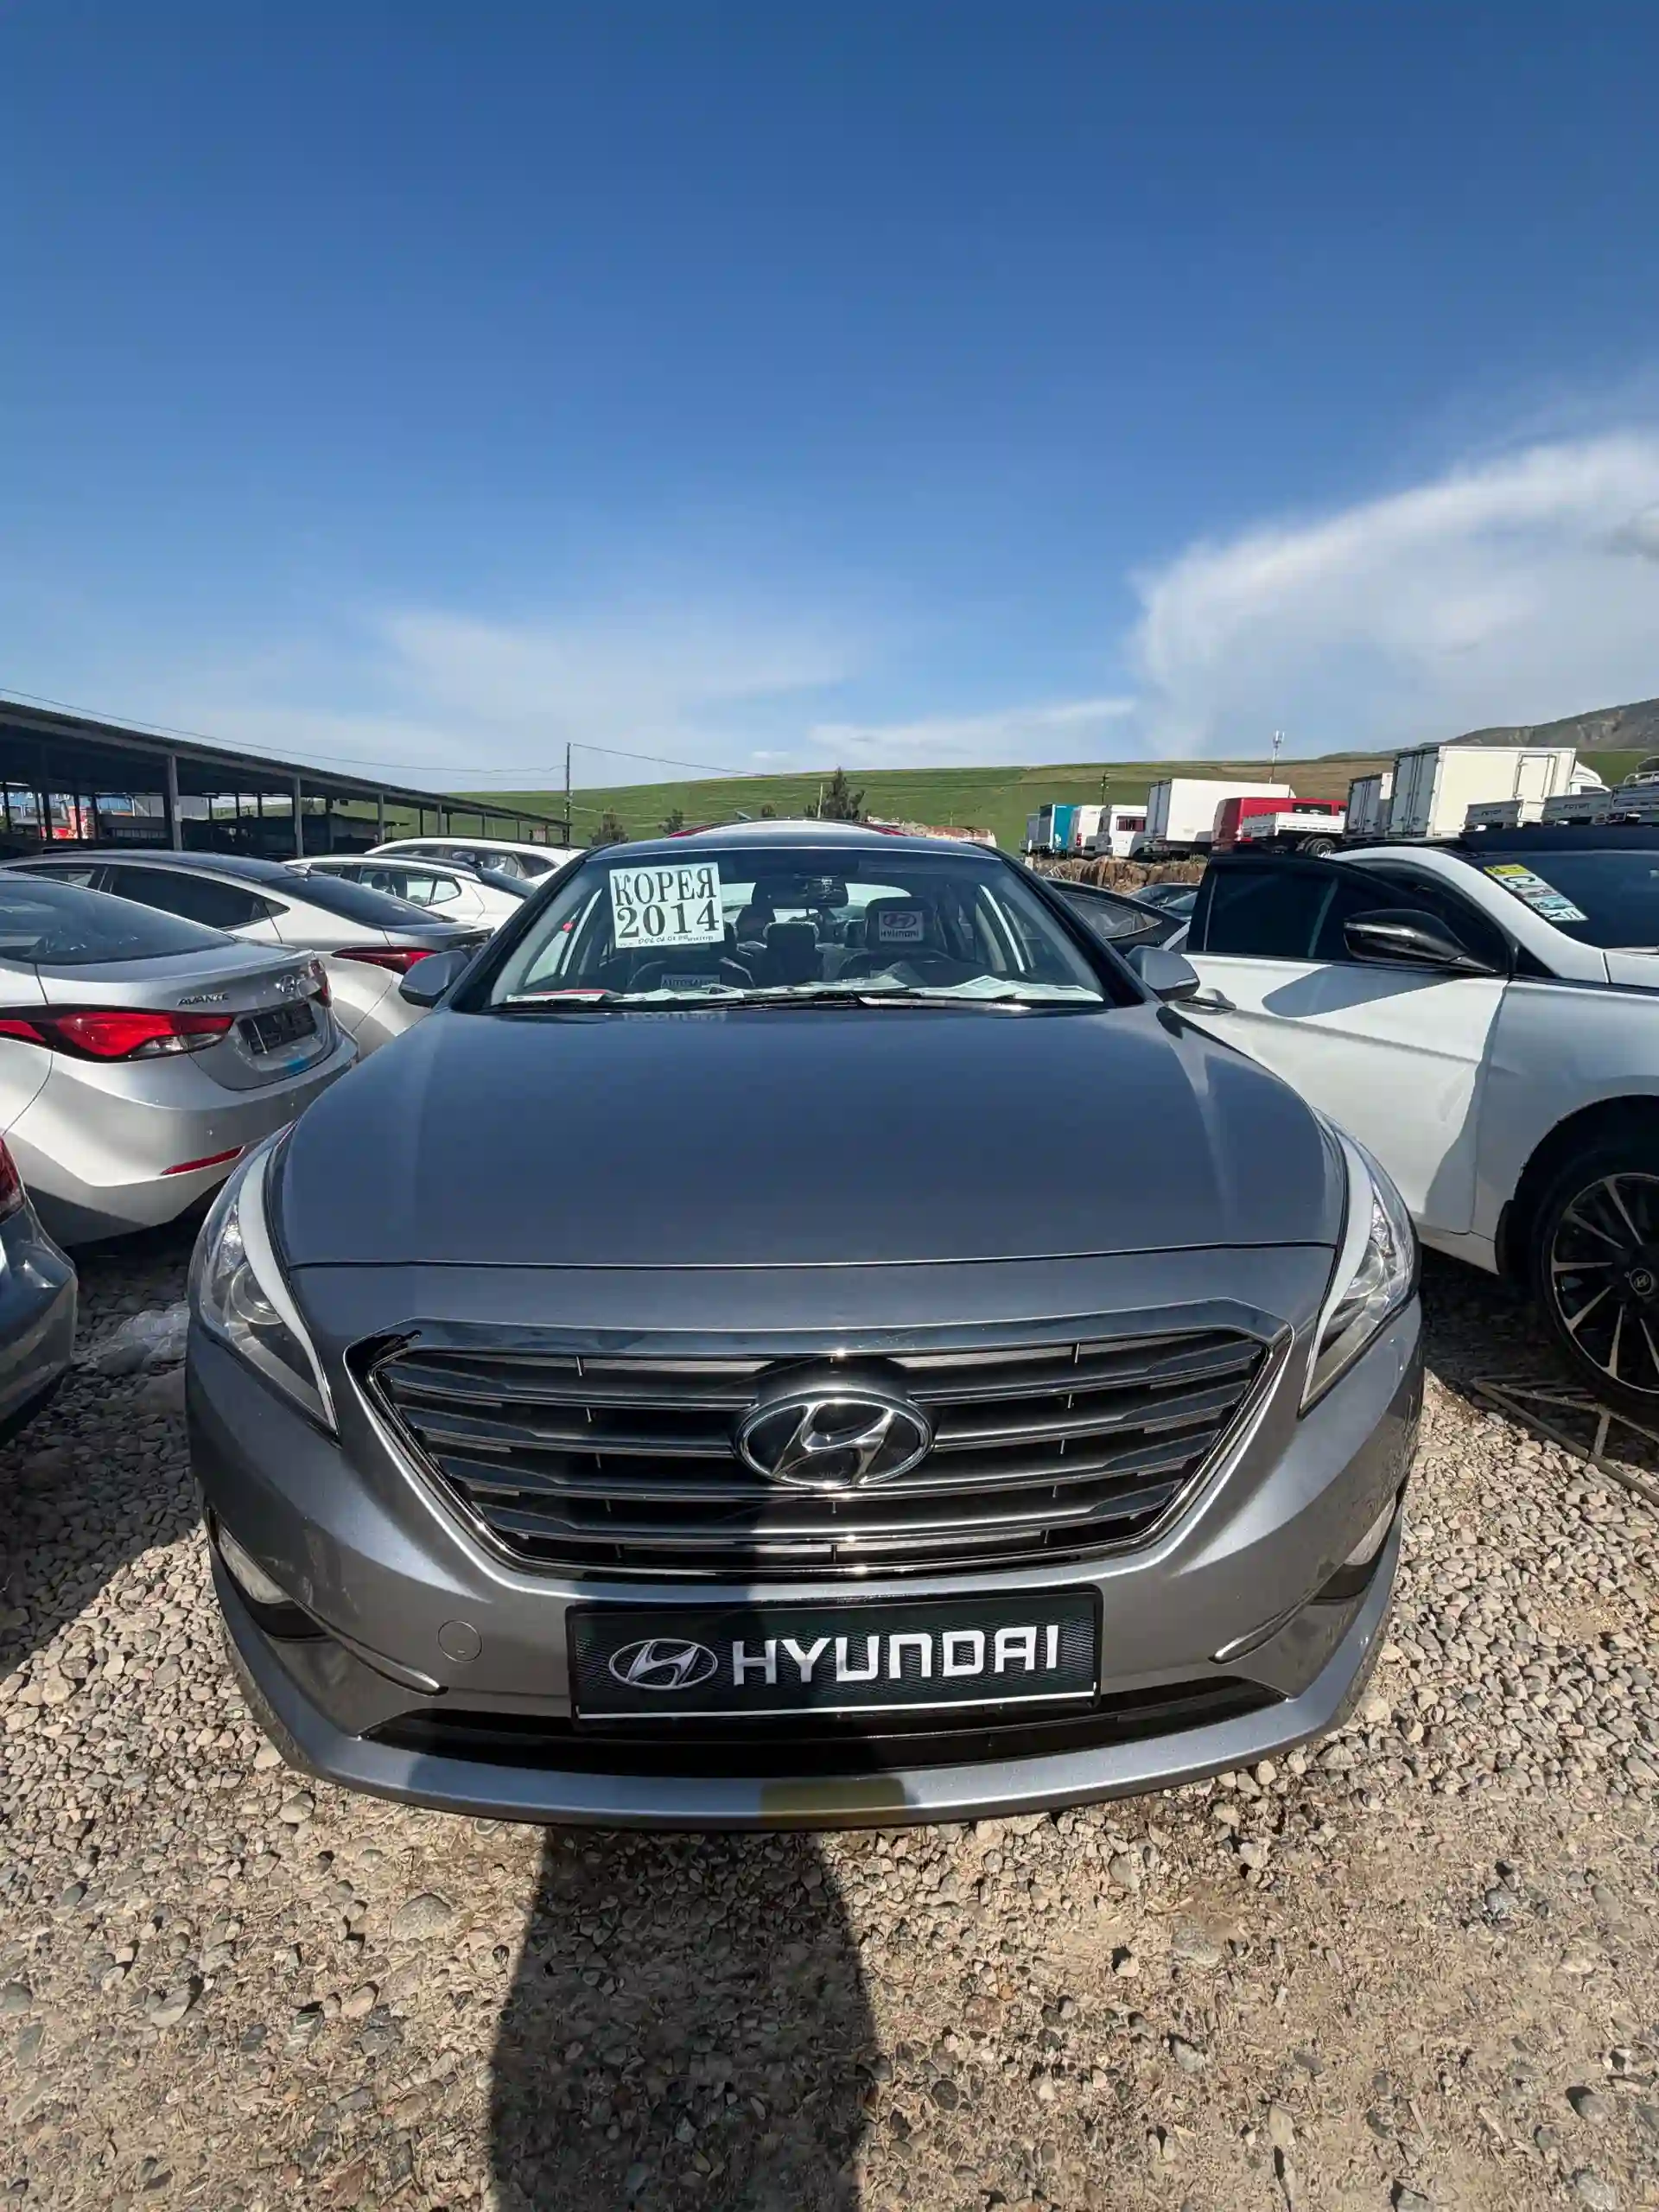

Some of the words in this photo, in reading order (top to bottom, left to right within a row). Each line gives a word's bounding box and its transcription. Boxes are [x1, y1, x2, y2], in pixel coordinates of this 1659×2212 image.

[613, 867, 717, 906] КОРЕЯ
[617, 899, 719, 939] 2014
[176, 992, 230, 1006] AVANTE
[733, 1624, 1059, 1686] HYUNDAI
